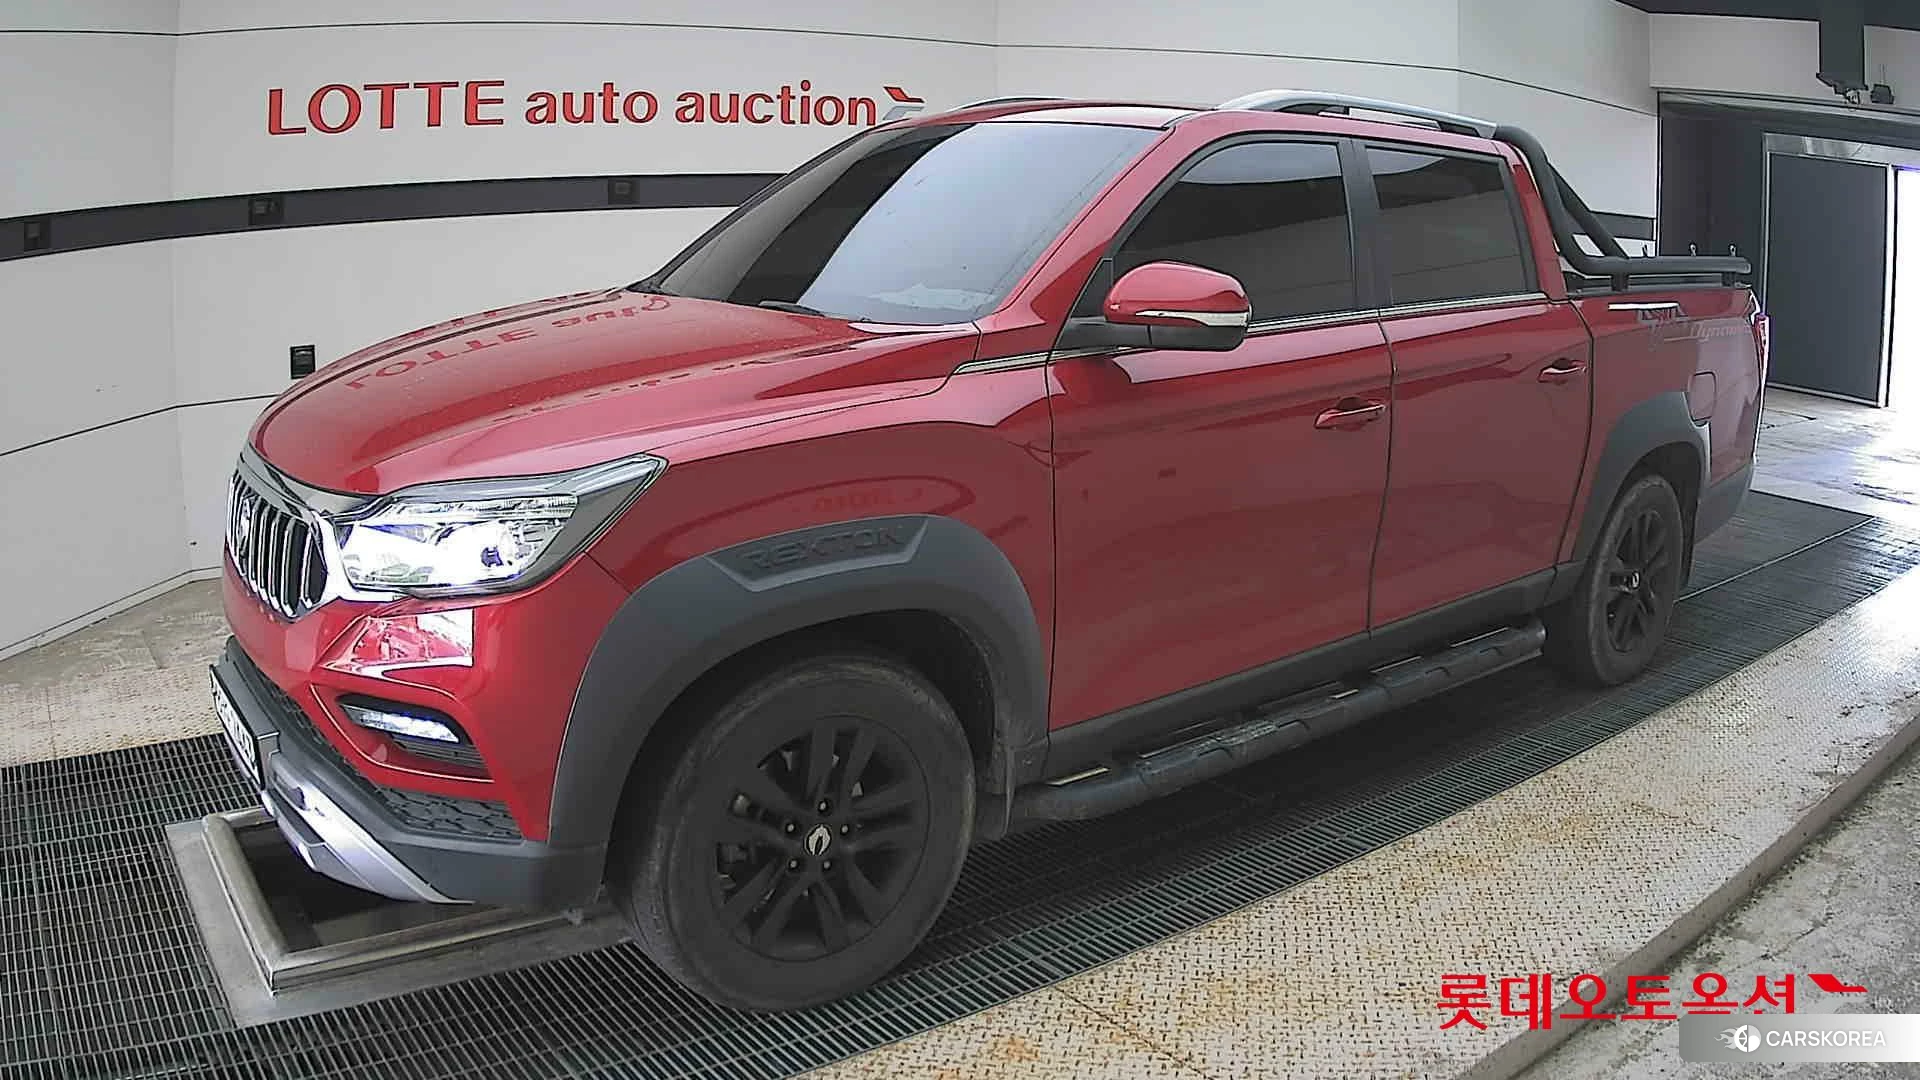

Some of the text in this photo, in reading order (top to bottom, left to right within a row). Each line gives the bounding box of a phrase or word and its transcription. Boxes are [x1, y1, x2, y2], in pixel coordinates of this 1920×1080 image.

[268, 79, 878, 135] LOTTE auto auction
